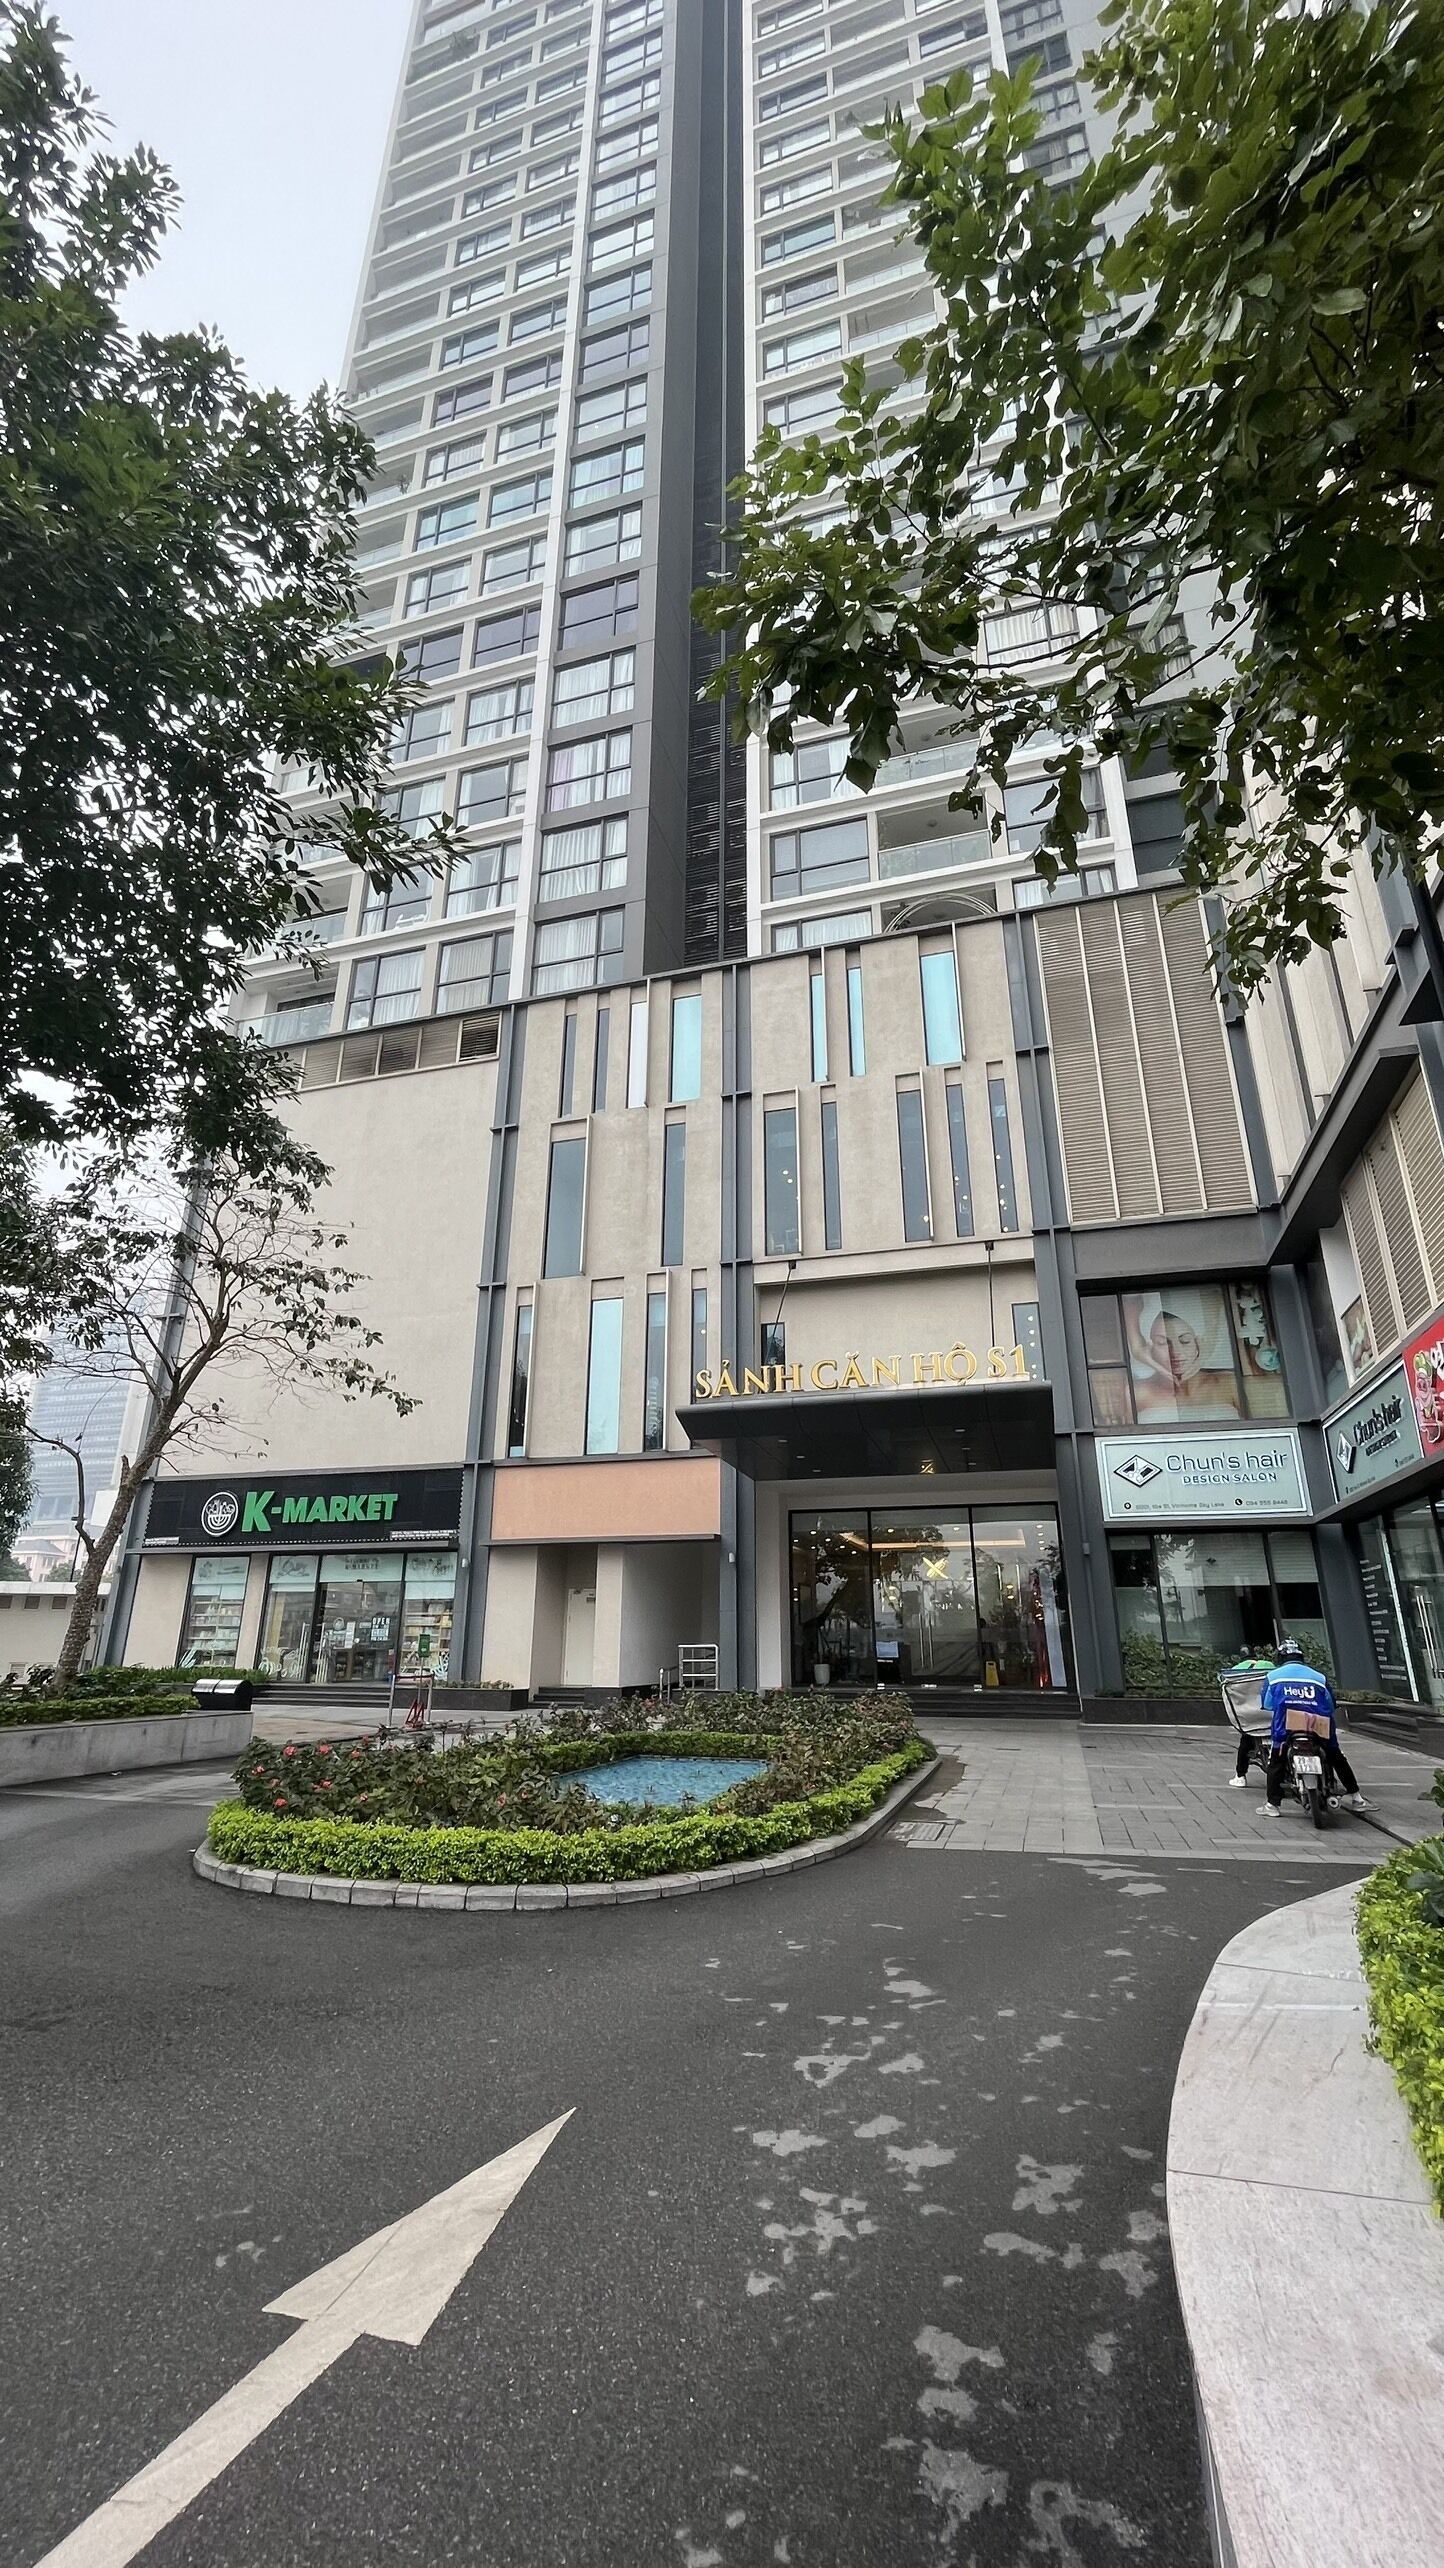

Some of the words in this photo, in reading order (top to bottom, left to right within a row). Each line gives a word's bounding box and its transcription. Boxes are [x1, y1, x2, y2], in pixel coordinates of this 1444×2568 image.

[695, 1359, 804, 1399] SẢNH
[812, 1351, 903, 1390] CĂN
[911, 1342, 978, 1386] HỘ
[987, 1344, 1031, 1378] S1
[1166, 1450, 1241, 1473] Chun's
[1245, 1448, 1289, 1471] hair
[1182, 1474, 1231, 1486] DESIGN
[1232, 1471, 1278, 1485] SALON
[241, 1490, 398, 1532] K-MARKET
[1283, 1685, 1316, 1699] HeyU
